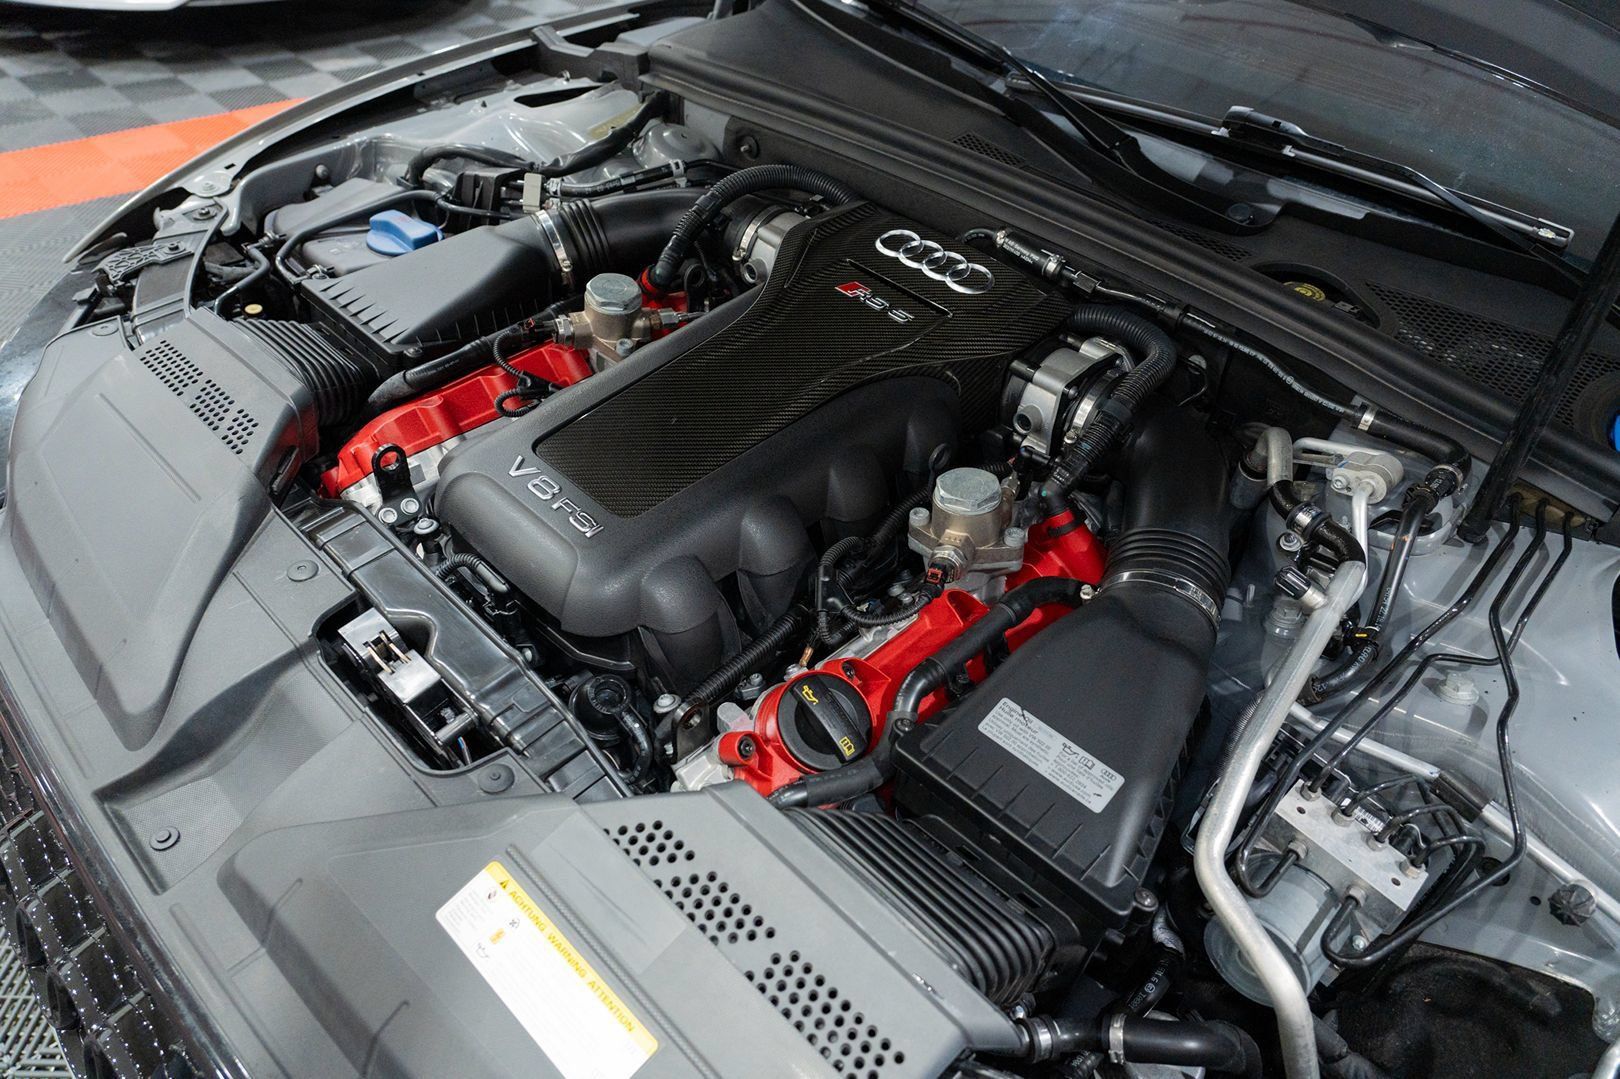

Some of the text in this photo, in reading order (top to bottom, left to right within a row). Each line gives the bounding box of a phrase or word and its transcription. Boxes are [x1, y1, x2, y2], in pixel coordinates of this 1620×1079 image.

[508, 455, 604, 538] V8 FSI
[509, 890, 635, 1032] ACHTUNG WARNING ATTENTION
